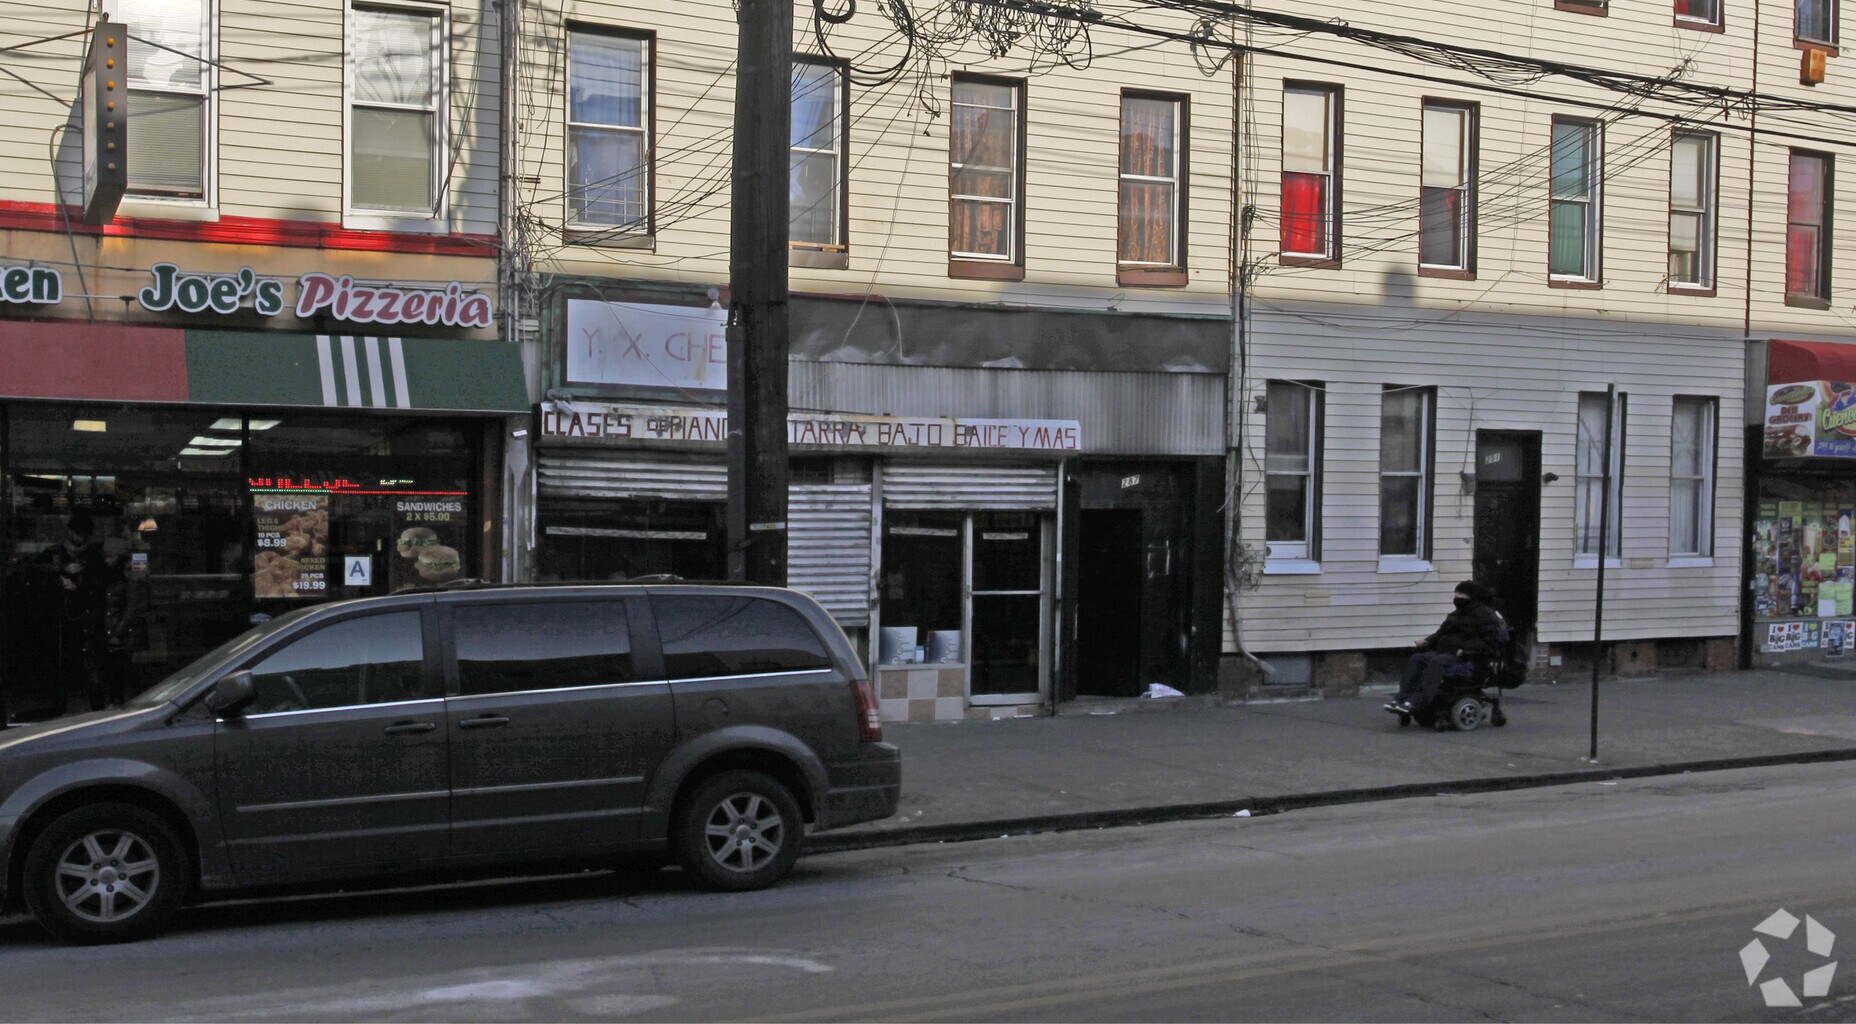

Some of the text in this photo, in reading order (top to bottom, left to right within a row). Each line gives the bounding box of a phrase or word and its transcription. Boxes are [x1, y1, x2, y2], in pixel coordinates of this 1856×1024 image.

[0, 266, 62, 304] en
[139, 262, 494, 328] Joe's Pizzeria
[544, 411, 631, 438] CLASES
[787, 420, 865, 444] TARRA
[878, 422, 942, 446] BAJO
[265, 500, 317, 510] CHICKEN
[397, 501, 462, 512] SANDWICHES
[423, 512, 451, 521] $5.00
[257, 538, 287, 547] $8.99
[350, 561, 366, 577] A
[292, 581, 326, 590] $19.99
